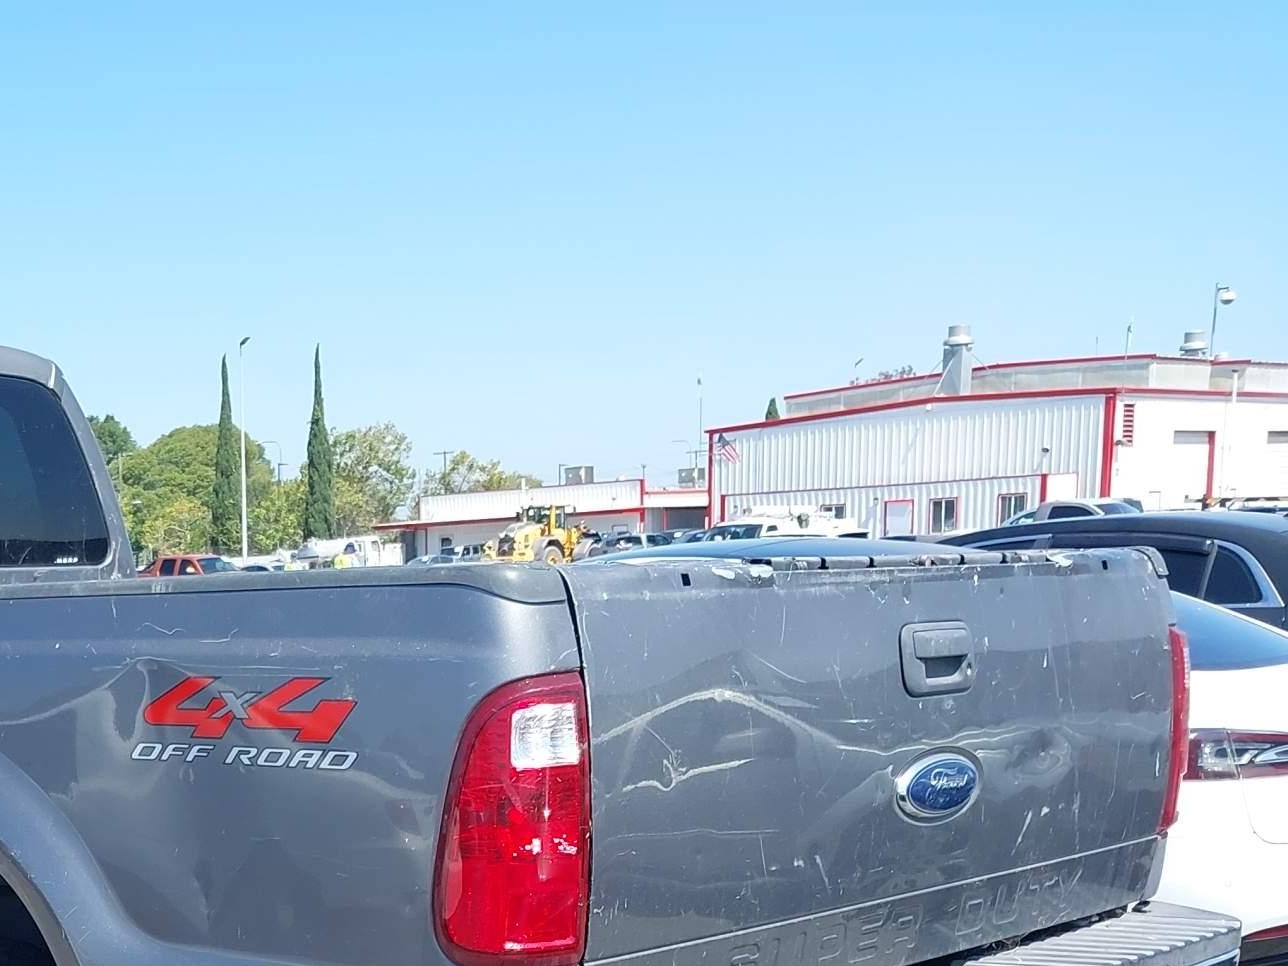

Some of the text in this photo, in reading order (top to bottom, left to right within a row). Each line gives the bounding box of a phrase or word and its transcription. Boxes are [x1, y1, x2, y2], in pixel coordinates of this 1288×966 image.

[131, 743, 359, 771] OFF ROAD
[930, 767, 969, 791] Ford
[955, 858, 1086, 937] DUTY
